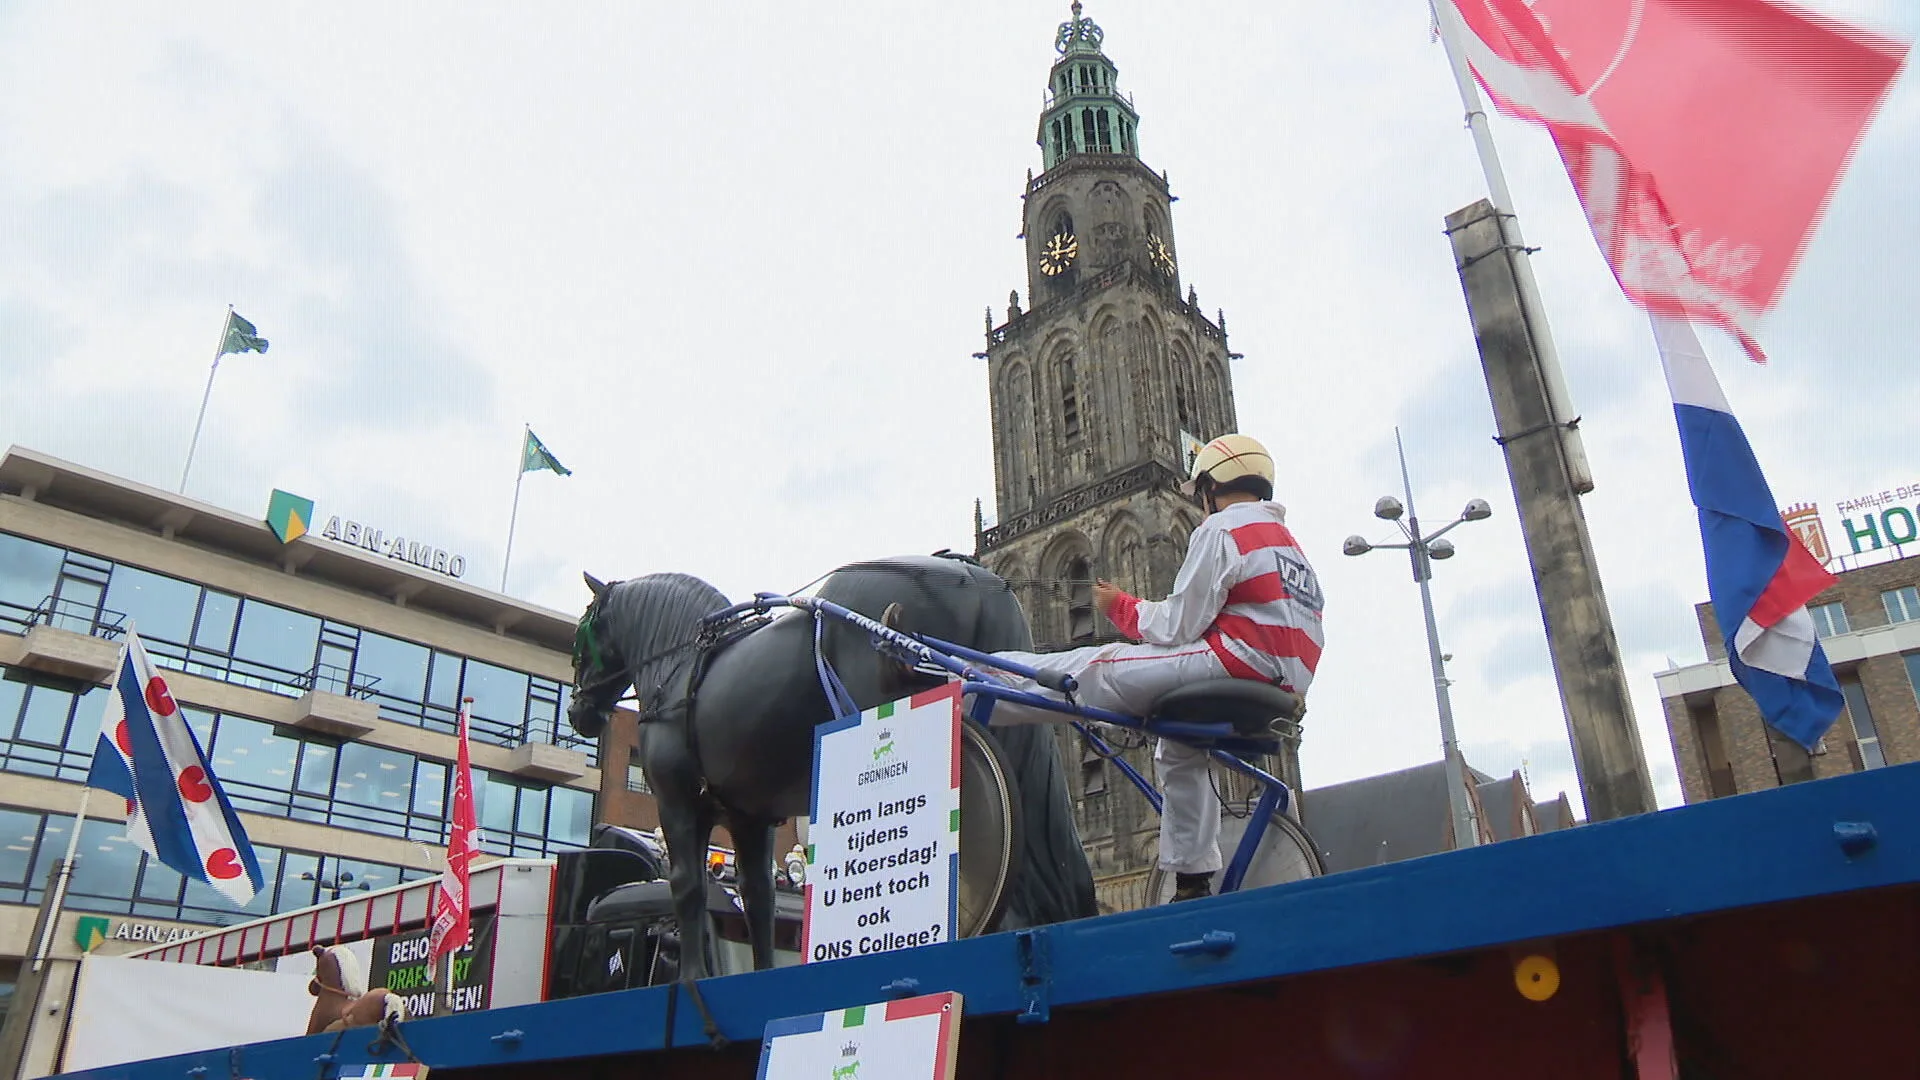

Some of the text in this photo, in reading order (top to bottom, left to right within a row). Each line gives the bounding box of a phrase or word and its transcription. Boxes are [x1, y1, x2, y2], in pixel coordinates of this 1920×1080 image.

[1836, 490, 1893, 513] FAMILIE
[1841, 506, 1920, 555] HO
[858, 760, 909, 786] GRONINGEN
[833, 794, 926, 828] Kom langs
[847, 825, 908, 852] tijdens
[844, 840, 937, 877] Koersdag!
[823, 870, 929, 907] U bent toch
[857, 906, 890, 928] ook
[814, 923, 941, 961] ONS College?
